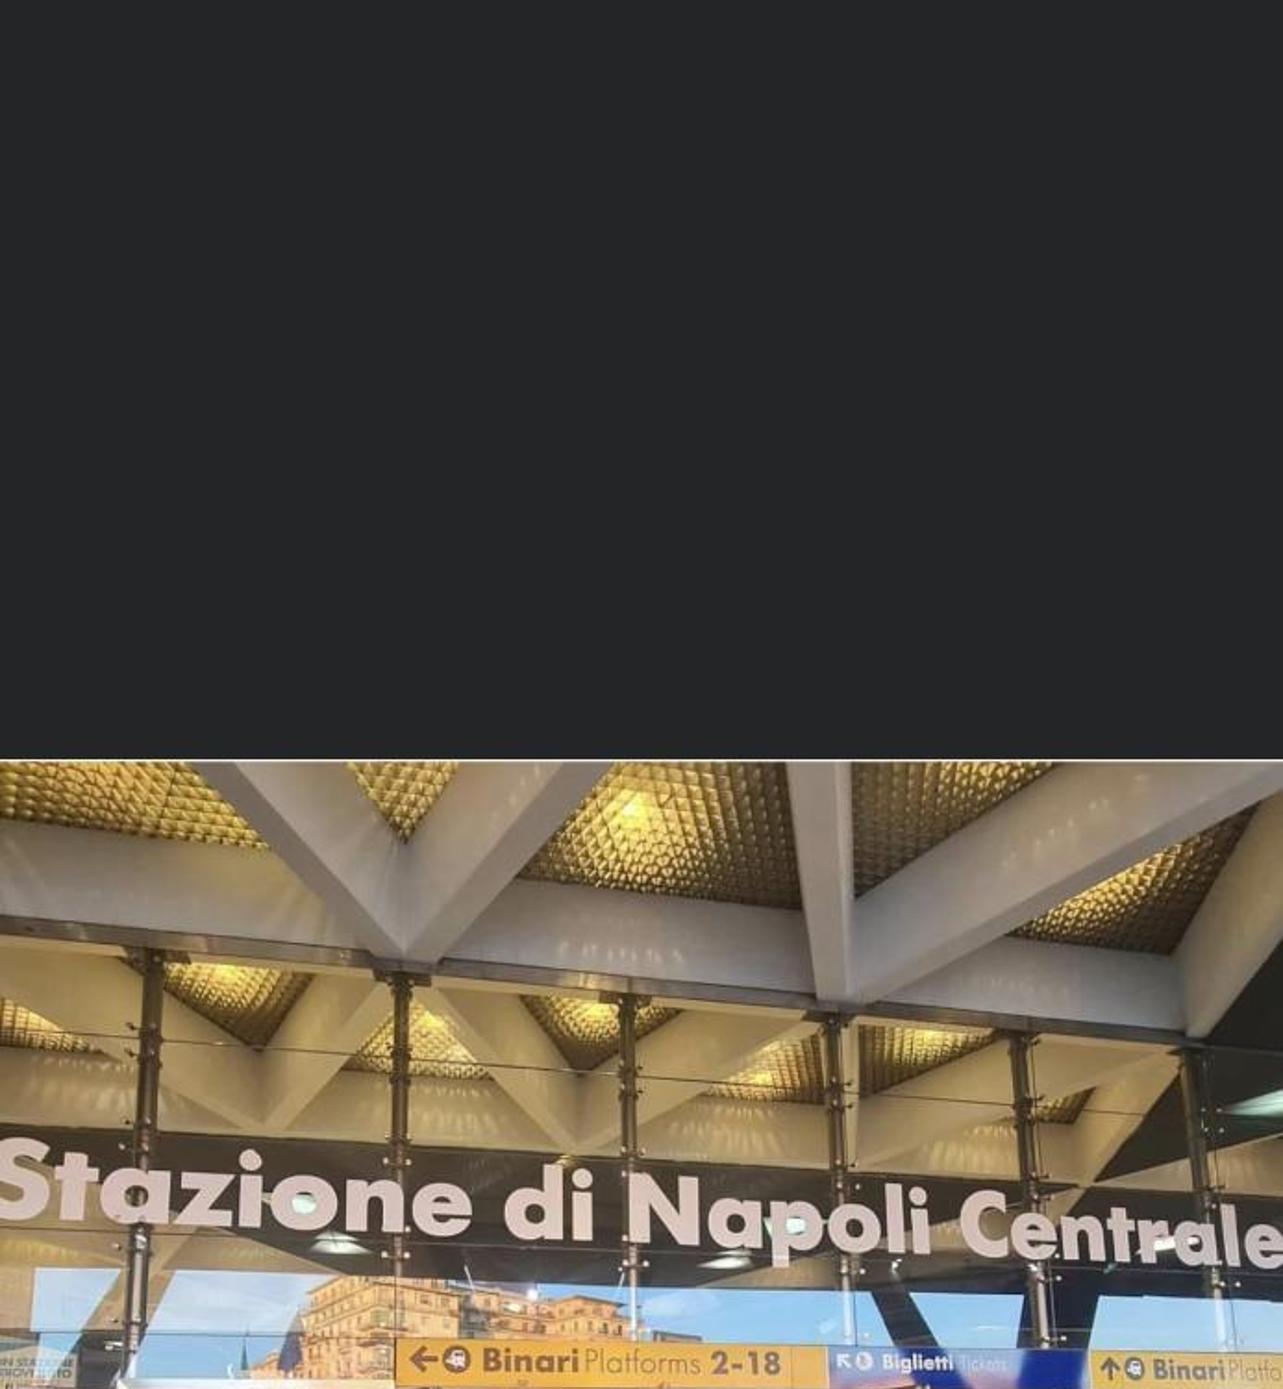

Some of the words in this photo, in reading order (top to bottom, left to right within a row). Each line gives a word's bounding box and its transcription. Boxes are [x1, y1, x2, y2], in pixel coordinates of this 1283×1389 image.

[0, 1136, 473, 1237] Stazione
[504, 1164, 594, 1242] di
[628, 1172, 931, 1268] Napoli
[959, 1189, 1283, 1267] Centrale
[482, 1348, 579, 1373] Binari
[584, 1348, 702, 1375] Platforms
[710, 1350, 782, 1376] 2-18
[882, 1352, 954, 1374] Biglietti
[1153, 1359, 1225, 1381] Binari
